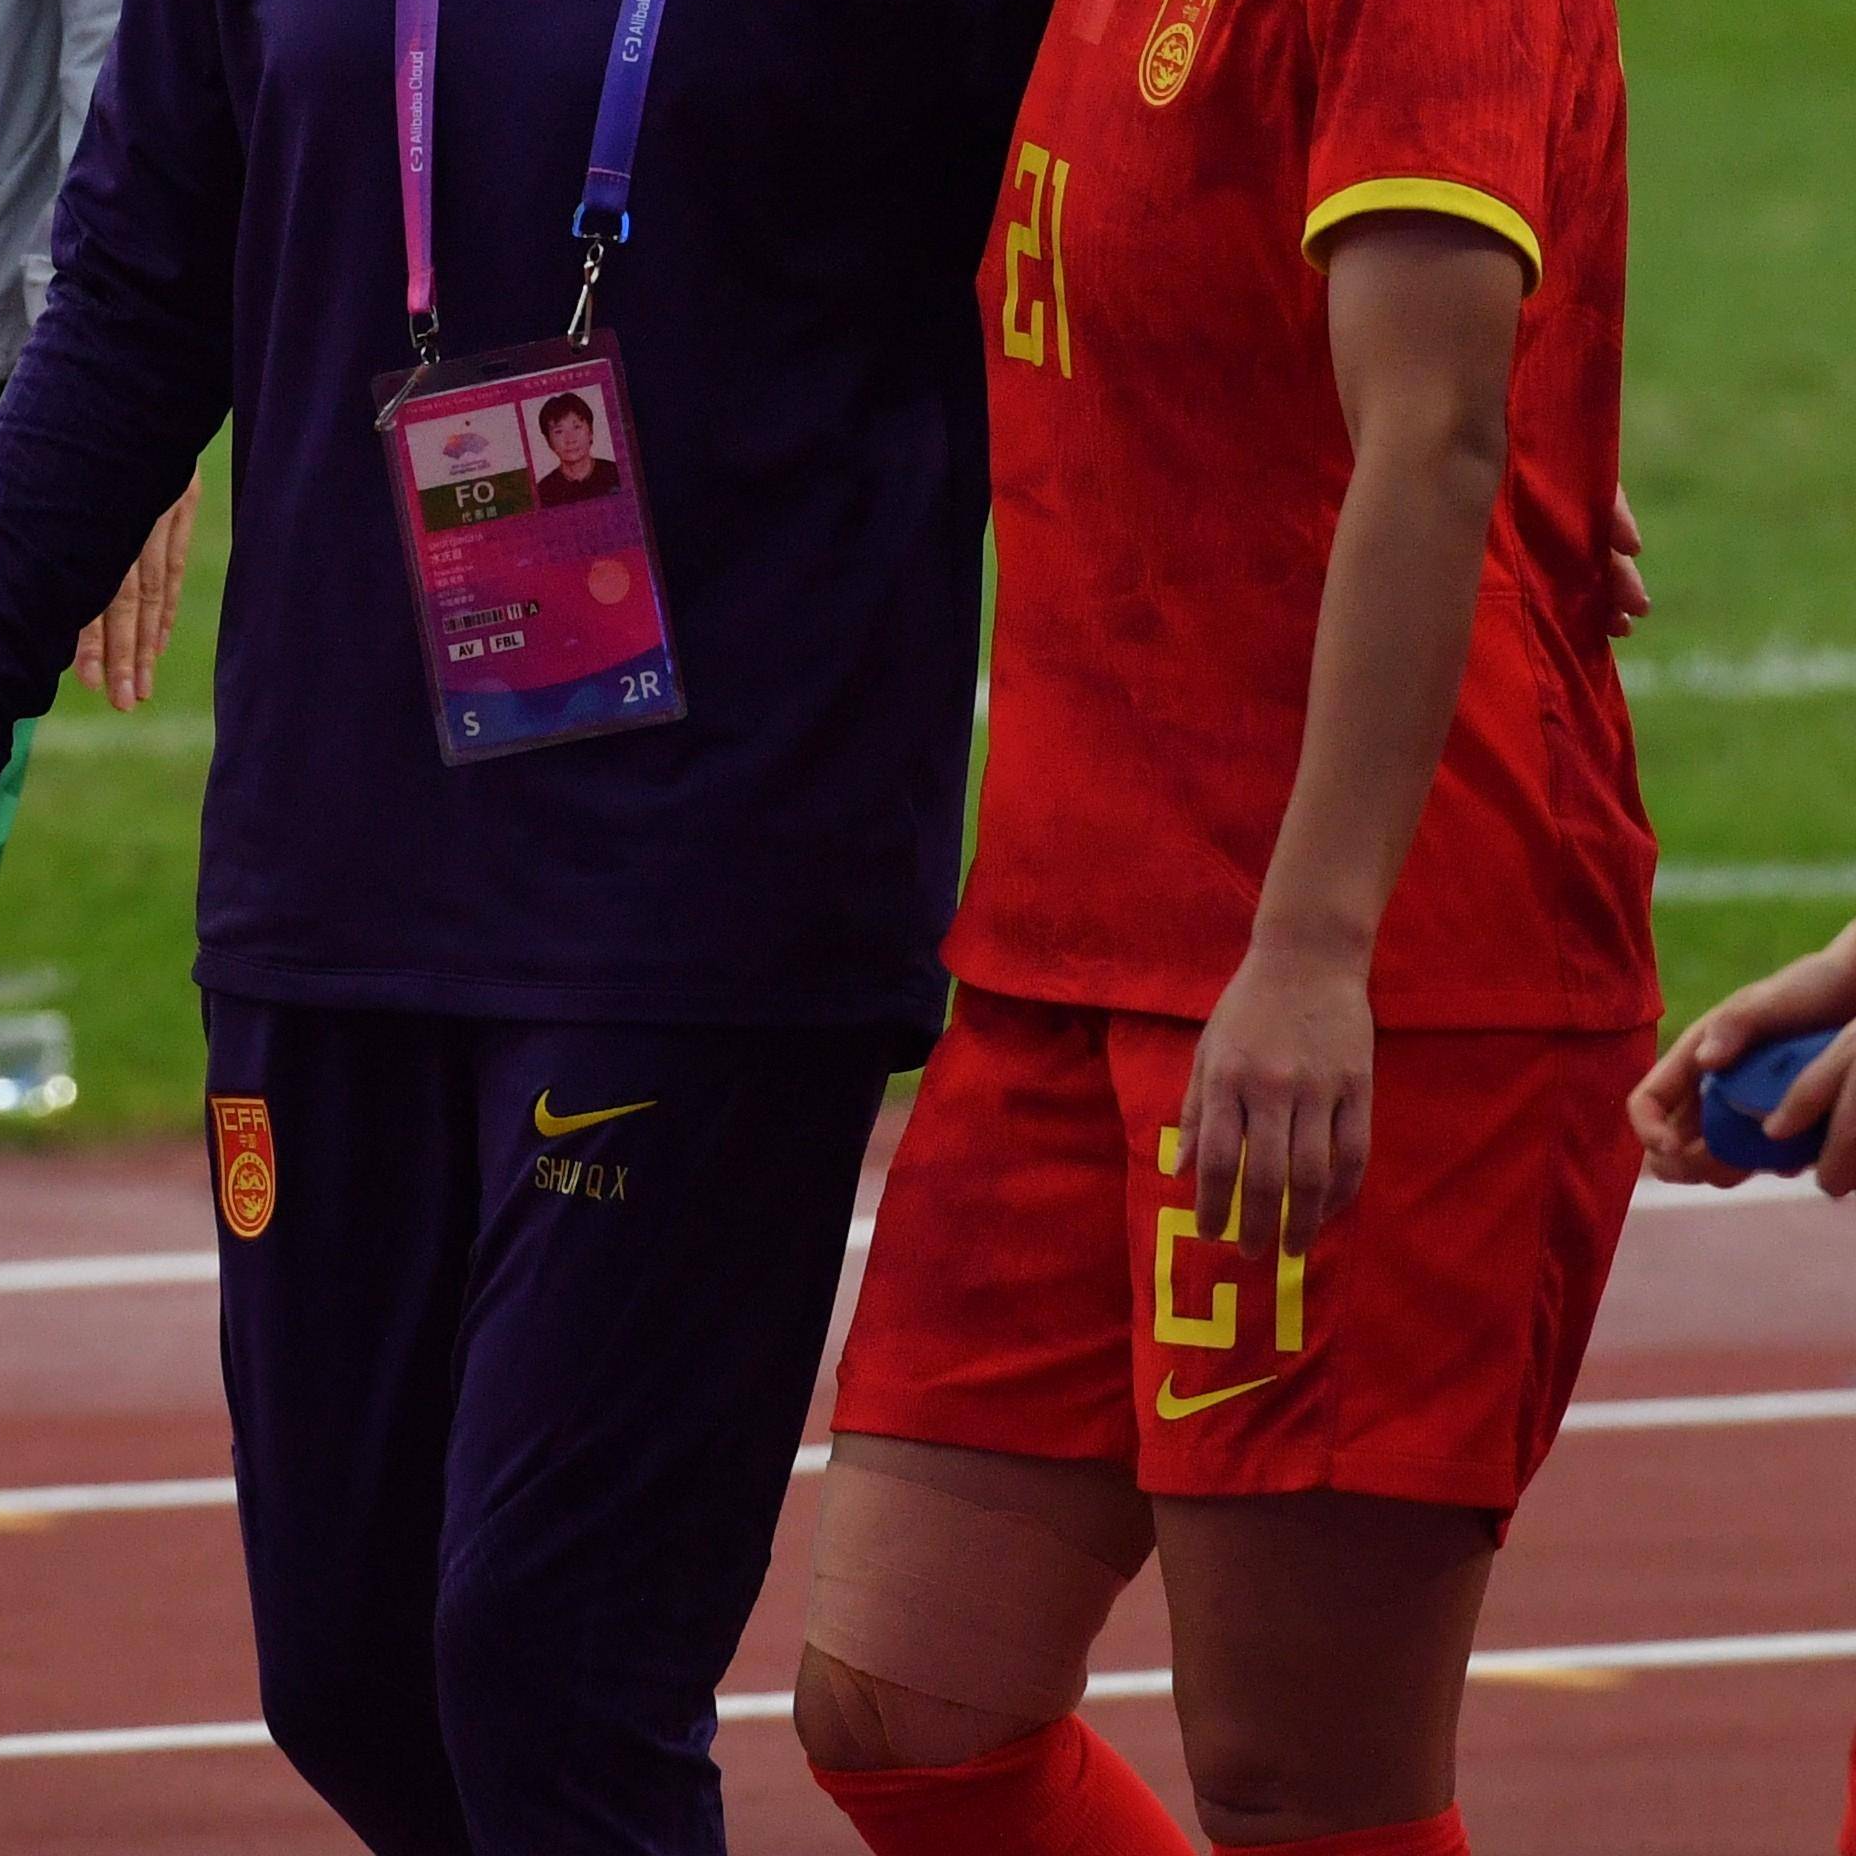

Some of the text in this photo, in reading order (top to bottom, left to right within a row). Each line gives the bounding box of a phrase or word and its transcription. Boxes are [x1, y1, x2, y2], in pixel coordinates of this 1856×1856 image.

[409, 51, 424, 144] Alibaba Cloud
[1003, 141, 1072, 379] 21
[456, 481, 494, 508] FO
[458, 633, 521, 658] AV FBL
[463, 670, 661, 737] S 2R
[222, 1107, 267, 1132] CFA
[535, 1155, 629, 1200] SHUI Q X
